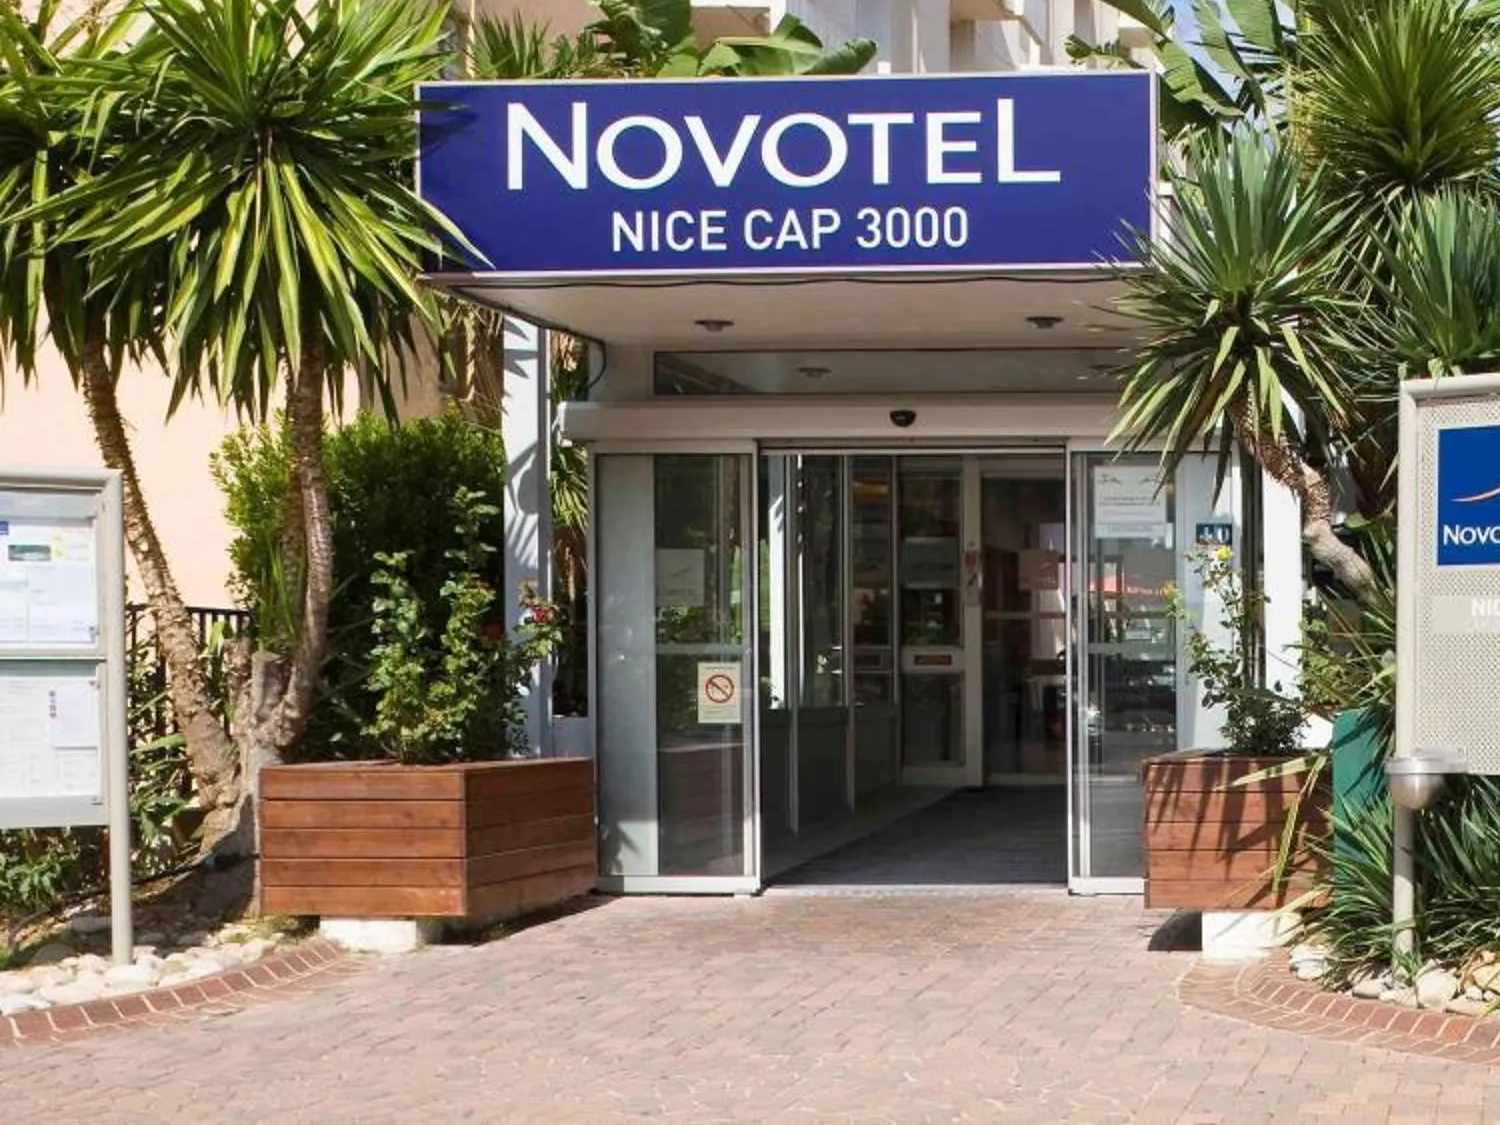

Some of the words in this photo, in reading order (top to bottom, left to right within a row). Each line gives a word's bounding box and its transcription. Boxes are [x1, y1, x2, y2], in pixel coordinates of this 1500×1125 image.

[508, 99, 1060, 189] NOVOTEL
[613, 211, 726, 251] NICE
[745, 209, 840, 249] CAP
[857, 207, 967, 247] 3000
